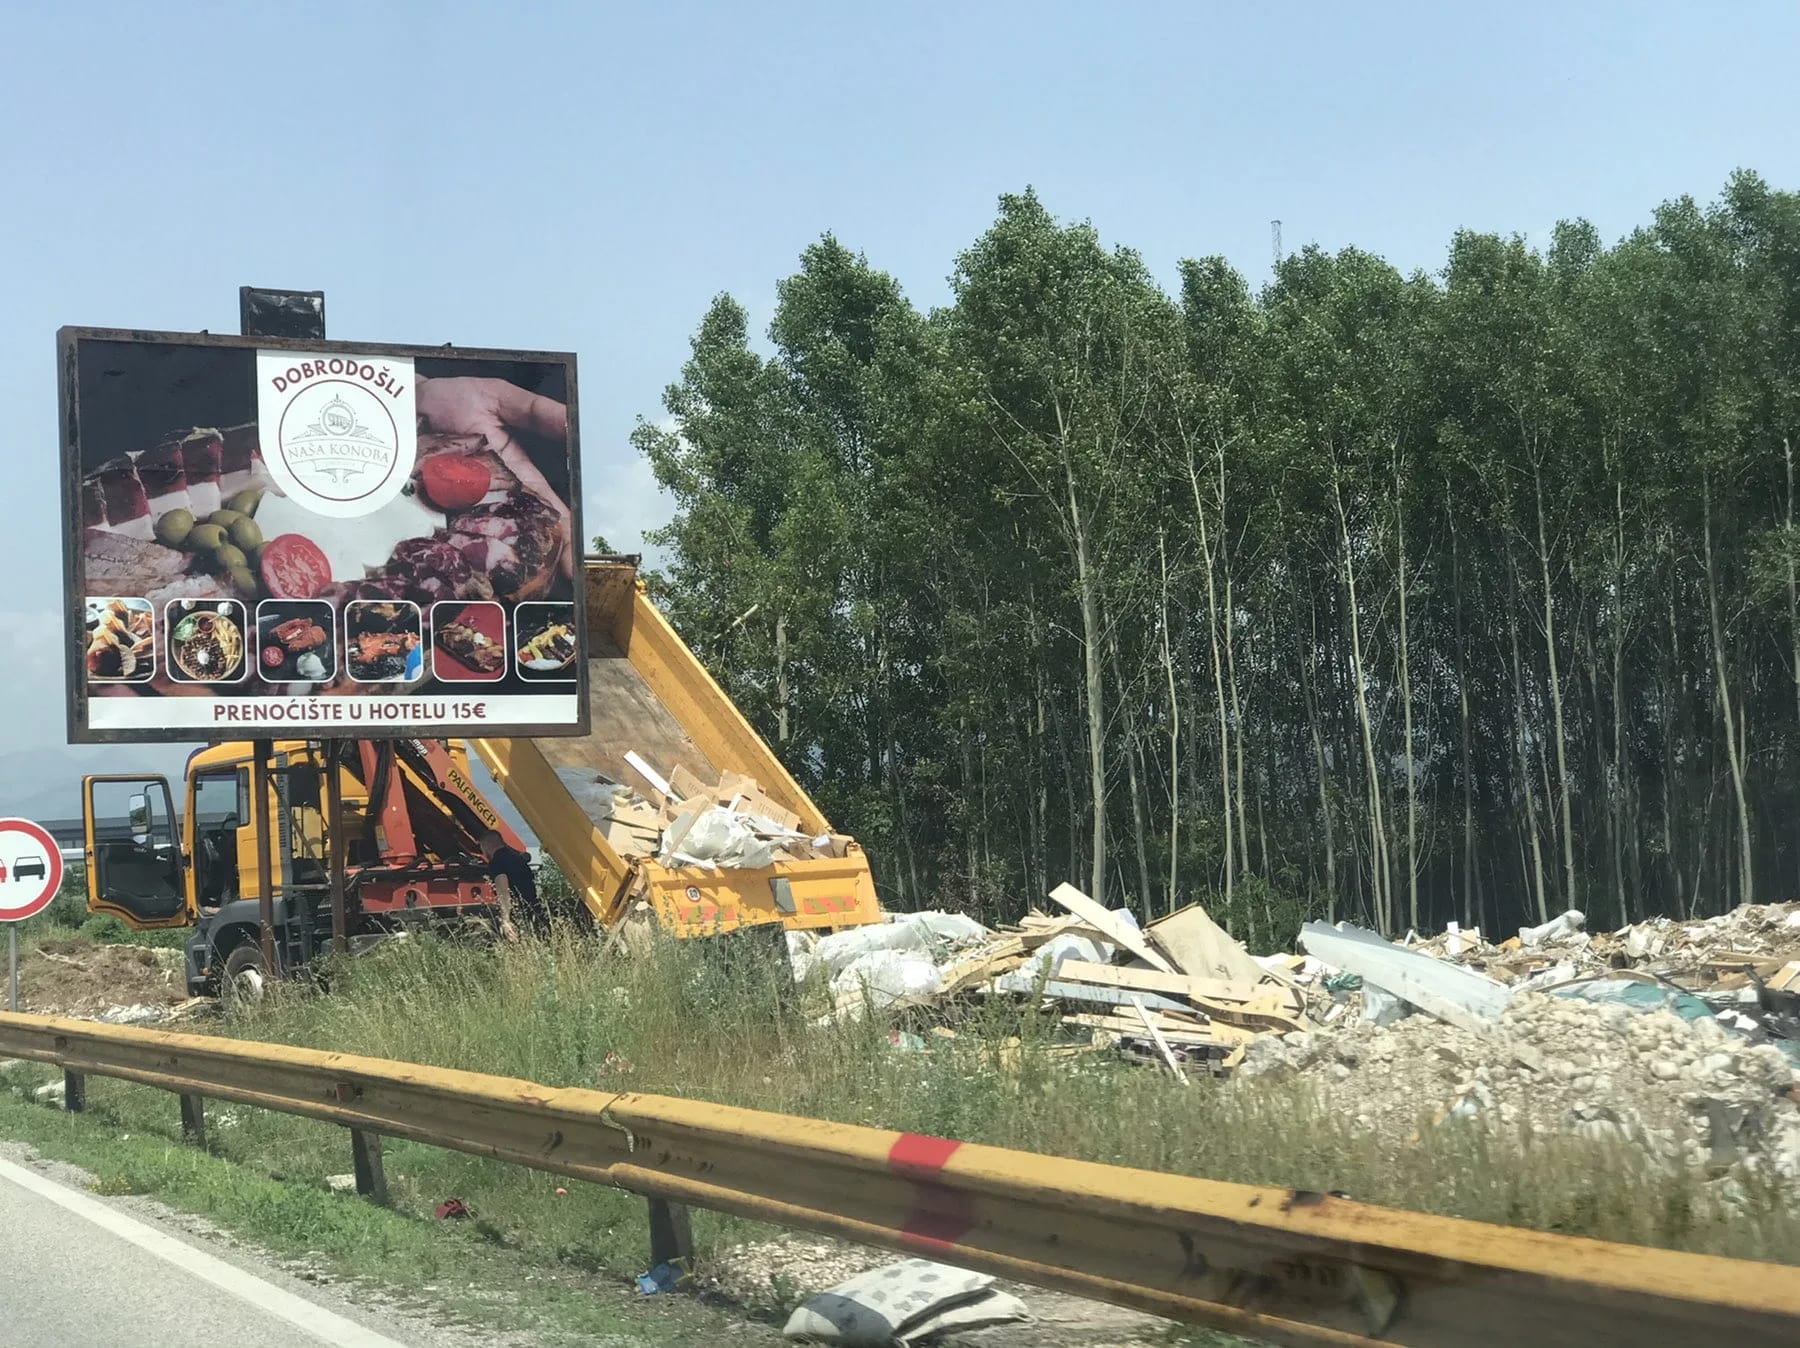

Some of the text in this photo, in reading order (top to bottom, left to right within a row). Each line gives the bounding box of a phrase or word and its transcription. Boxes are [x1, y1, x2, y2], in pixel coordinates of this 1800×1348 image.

[272, 358, 404, 399] DOBRODOŠLI
[288, 441, 389, 463] NAŠA KONOBA
[214, 698, 487, 721] PRENOĆIŠTE U HOTELU 15€
[447, 769, 497, 826] PALFINGER
